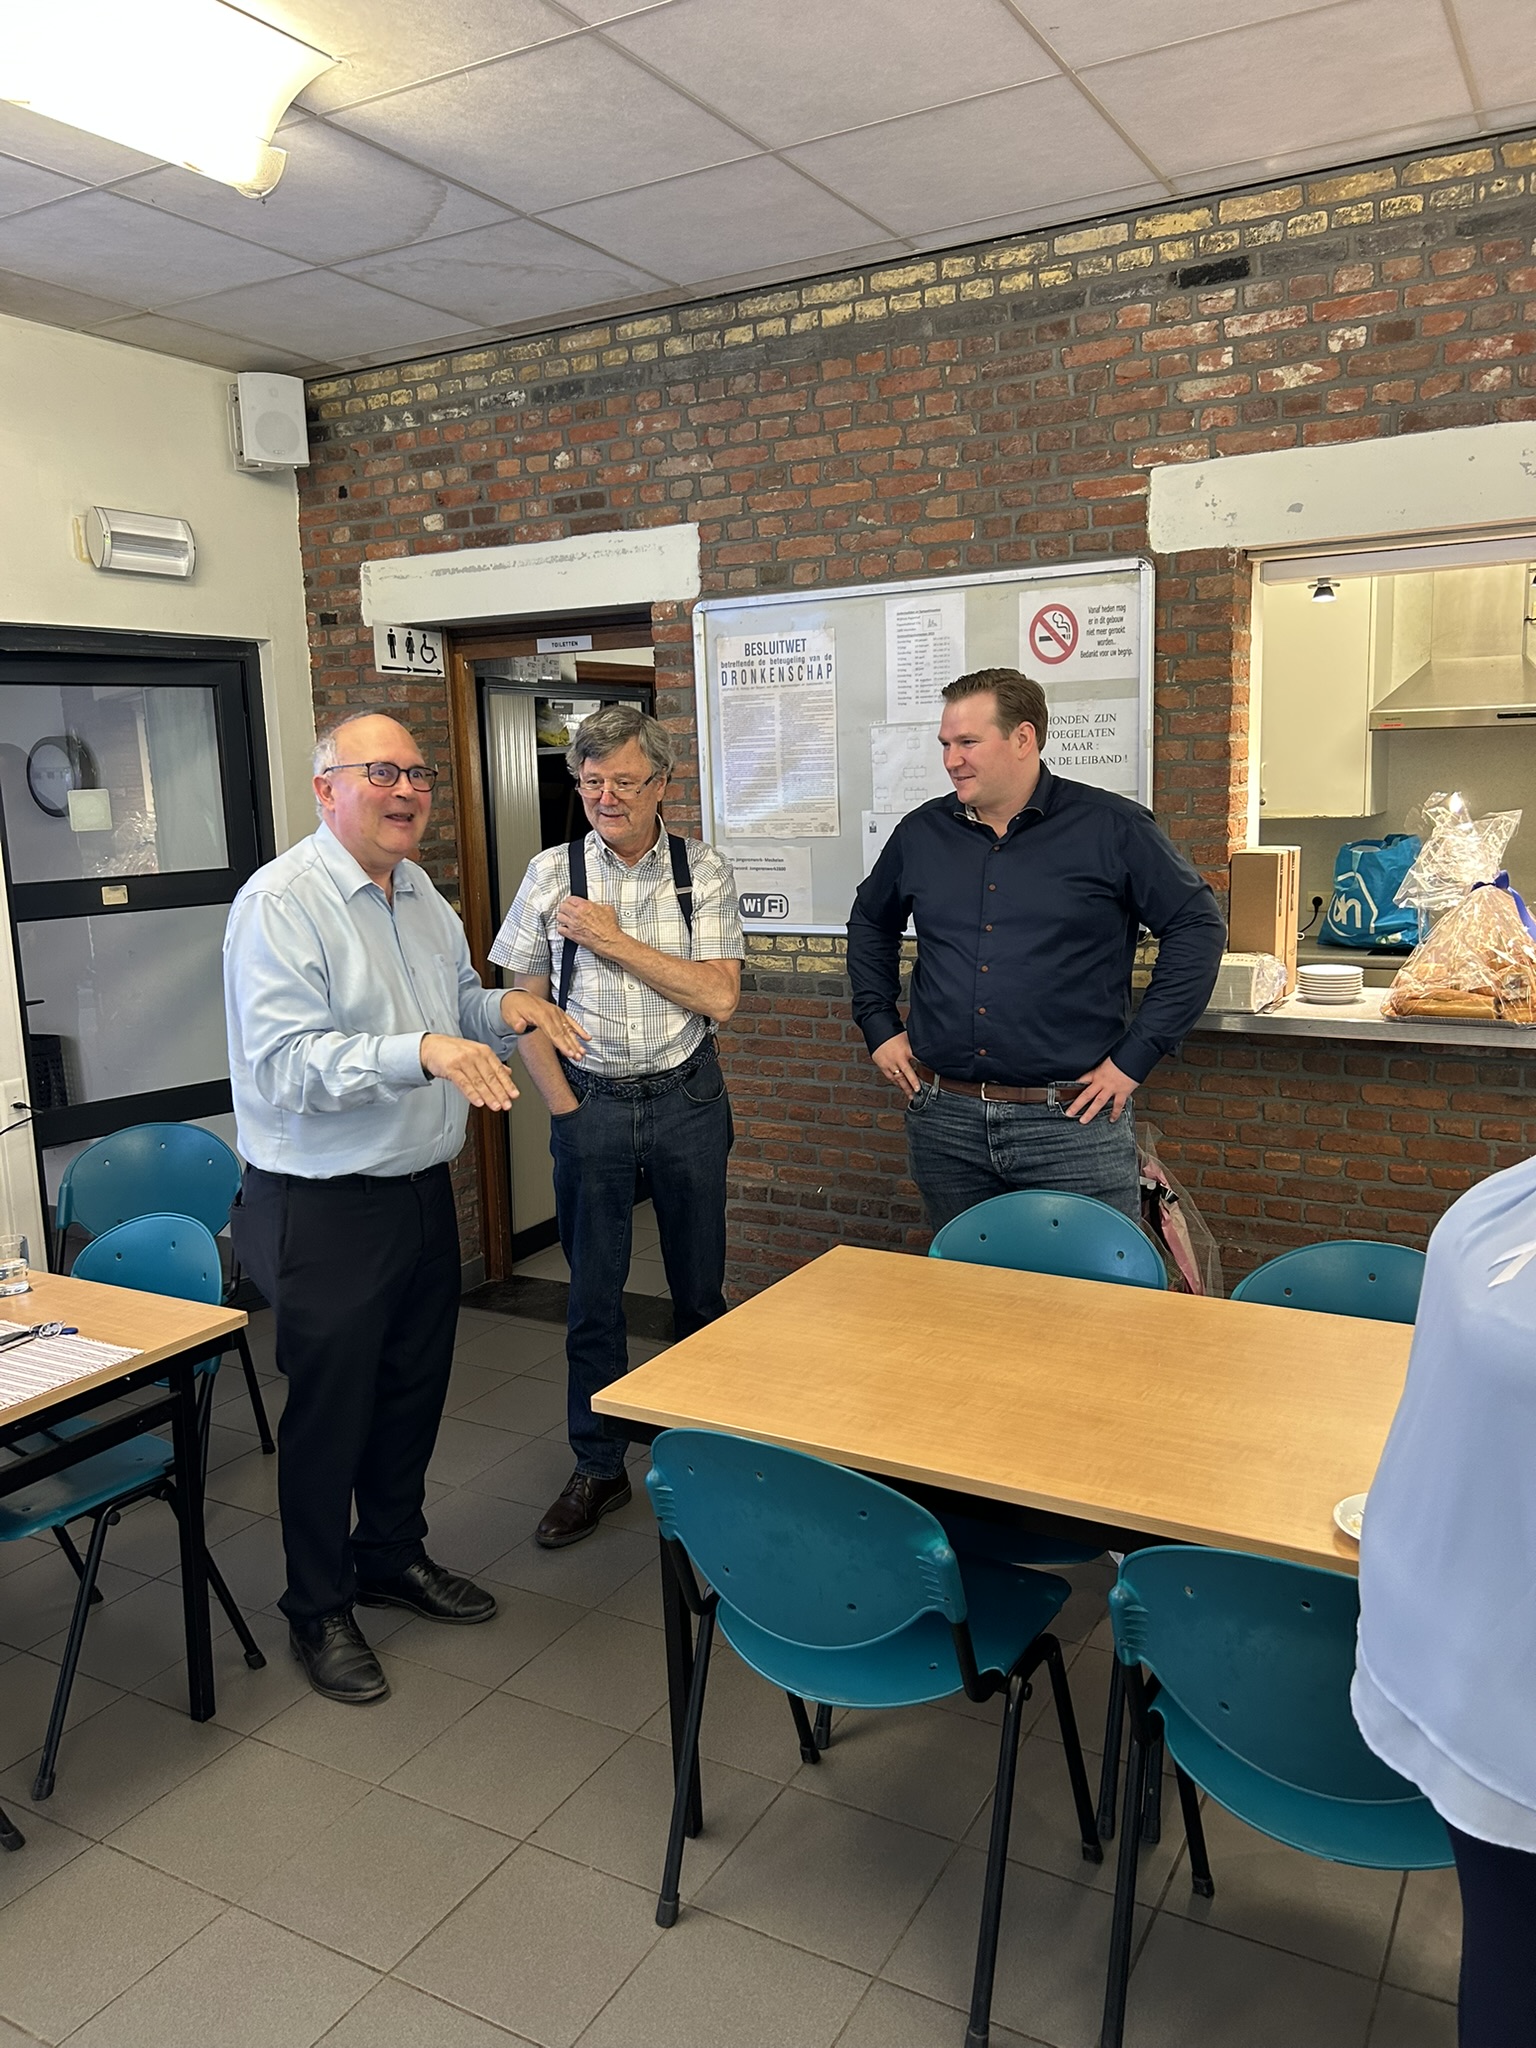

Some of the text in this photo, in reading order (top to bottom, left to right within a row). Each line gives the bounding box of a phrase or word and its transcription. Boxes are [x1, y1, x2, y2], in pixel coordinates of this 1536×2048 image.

[1088, 604, 1126, 614] Vanaf heden mag
[1094, 617, 1099, 625] in
[1106, 615, 1123, 625] gebouw
[1086, 625, 1126, 636] niet meer gerookt
[744, 638, 807, 656] BESLUITWET
[1080, 650, 1098, 659] Bedankt
[720, 659, 754, 669] betreffende
[758, 658, 766, 666] de
[769, 655, 806, 666] beteugeling
[824, 653, 832, 661] de
[721, 662, 833, 686] DRONKENSCHAP
[1094, 713, 1117, 723] ZIJN
[1047, 728, 1116, 739] TOEGELATEN
[1061, 741, 1093, 751] MAAR
[1058, 756, 1072, 765] DE
[1075, 754, 1122, 765] LEIBAND
